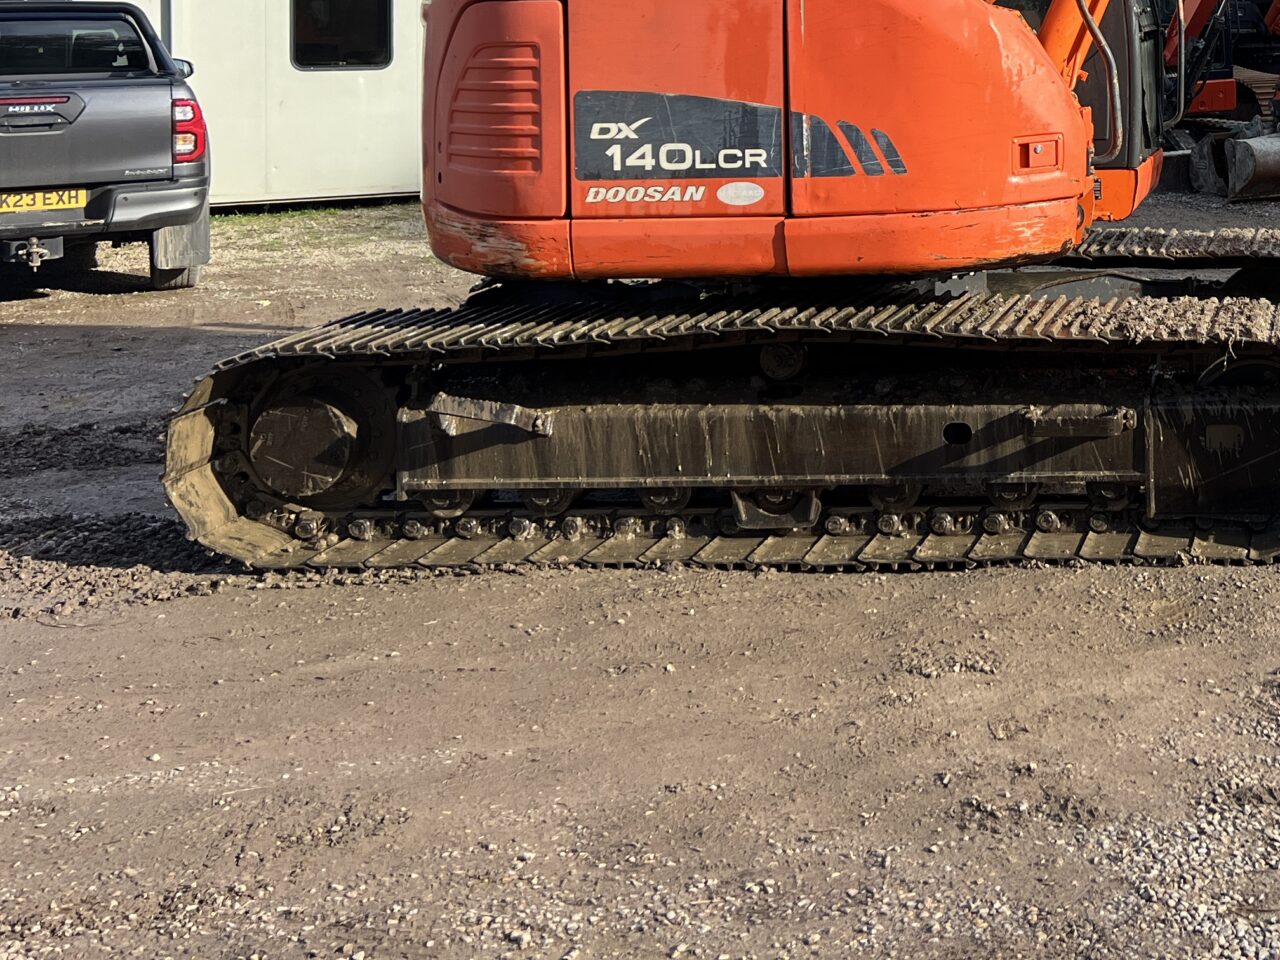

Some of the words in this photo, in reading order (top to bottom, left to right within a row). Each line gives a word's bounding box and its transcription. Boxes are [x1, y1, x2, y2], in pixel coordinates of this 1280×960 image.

[590, 117, 653, 139] DX
[43, 190, 79, 206] EXH
[585, 186, 706, 203] DOOSAN
